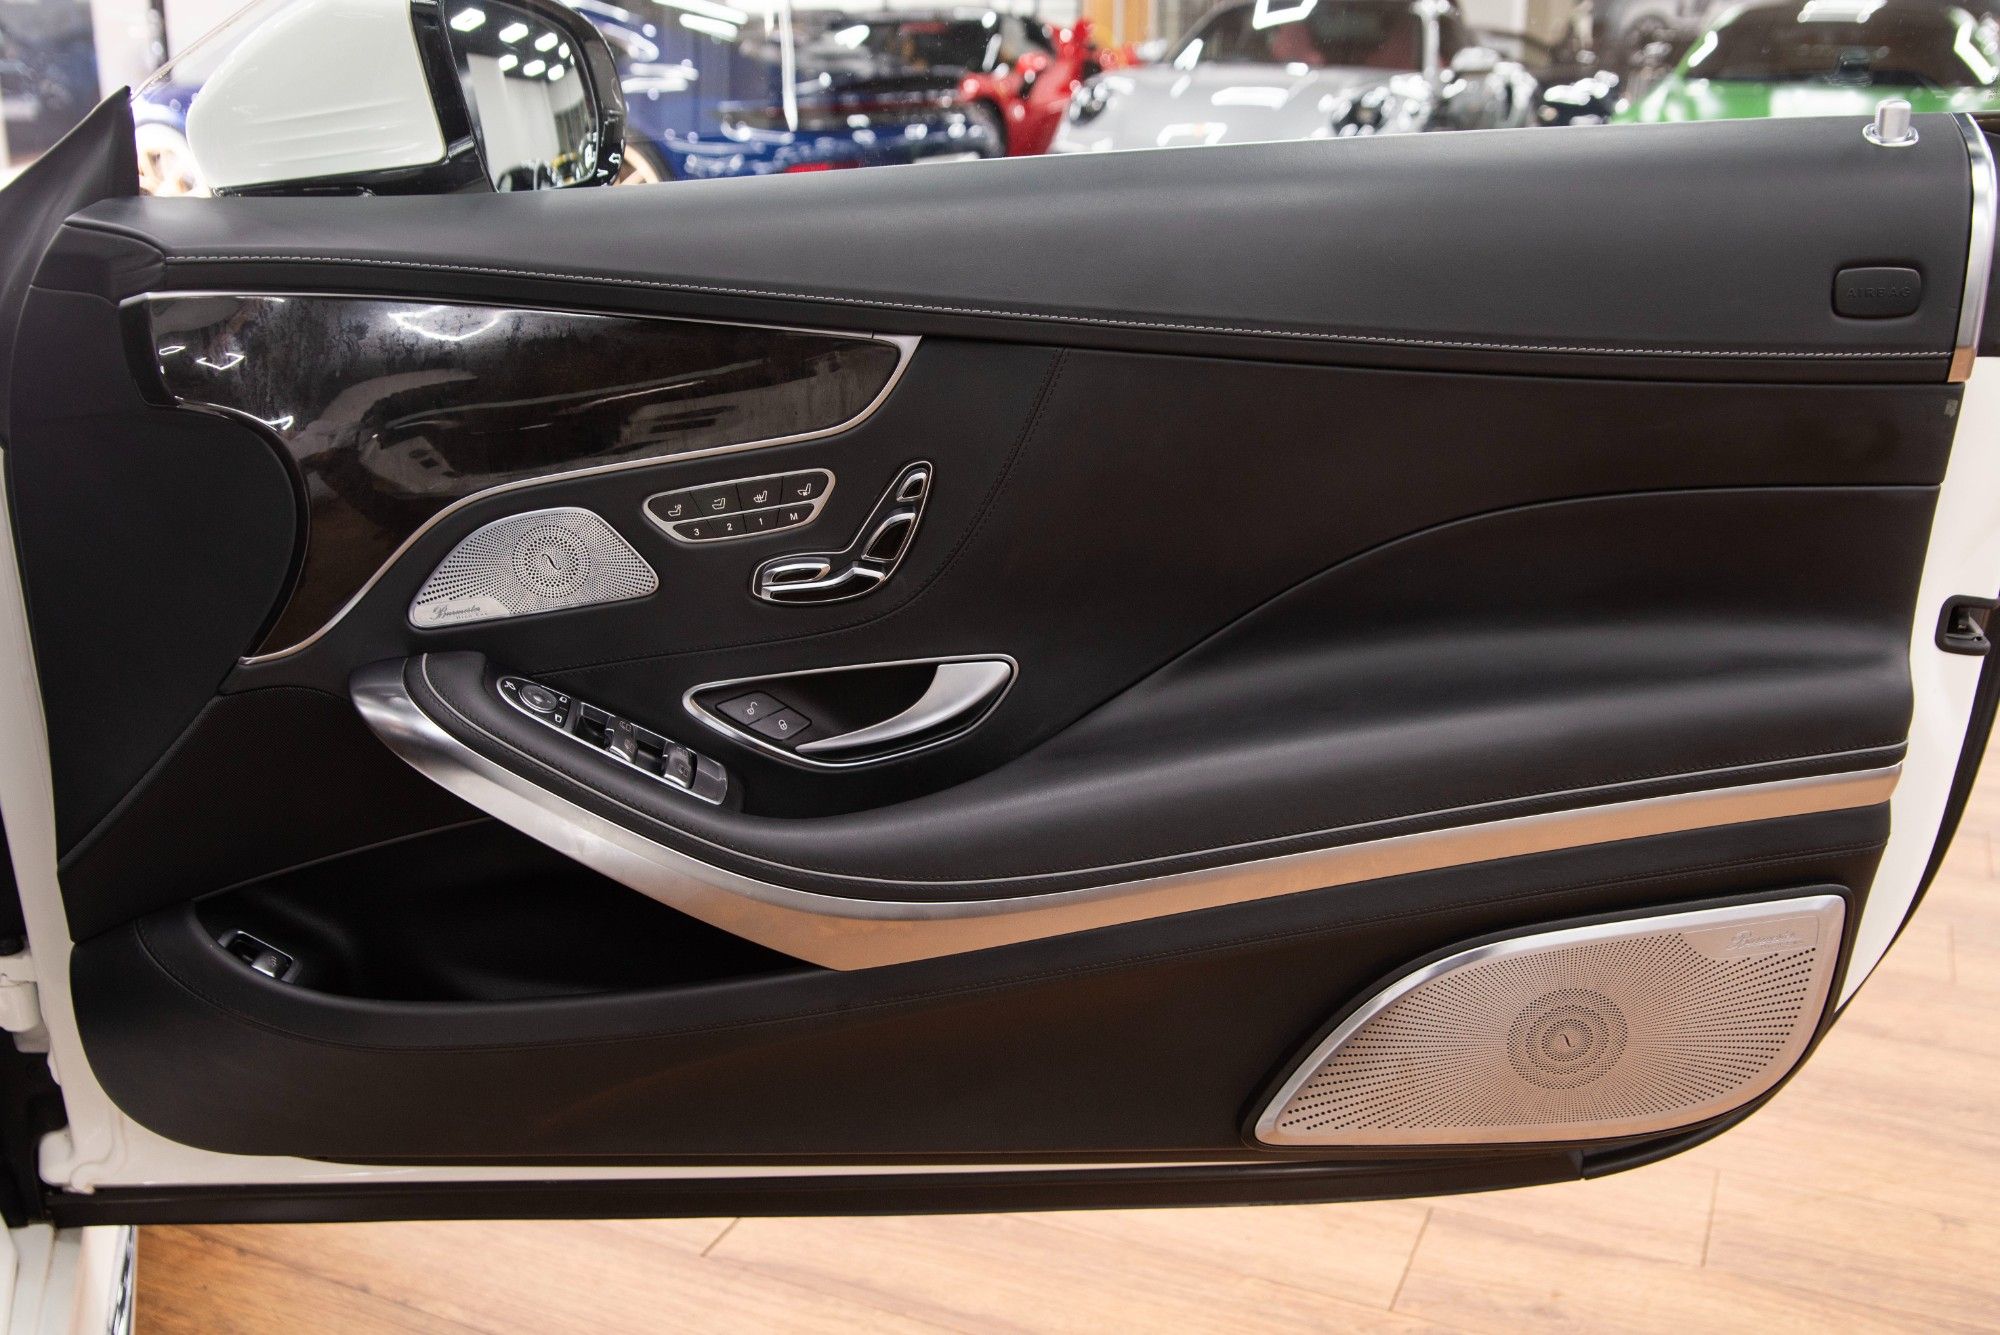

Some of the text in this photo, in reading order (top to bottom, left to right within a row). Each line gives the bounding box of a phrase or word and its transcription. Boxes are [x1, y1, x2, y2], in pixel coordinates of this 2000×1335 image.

[1847, 286, 1913, 298] AIRBAG
[693, 528, 700, 536] 3
[726, 523, 733, 531] 2
[789, 512, 799, 521] M
